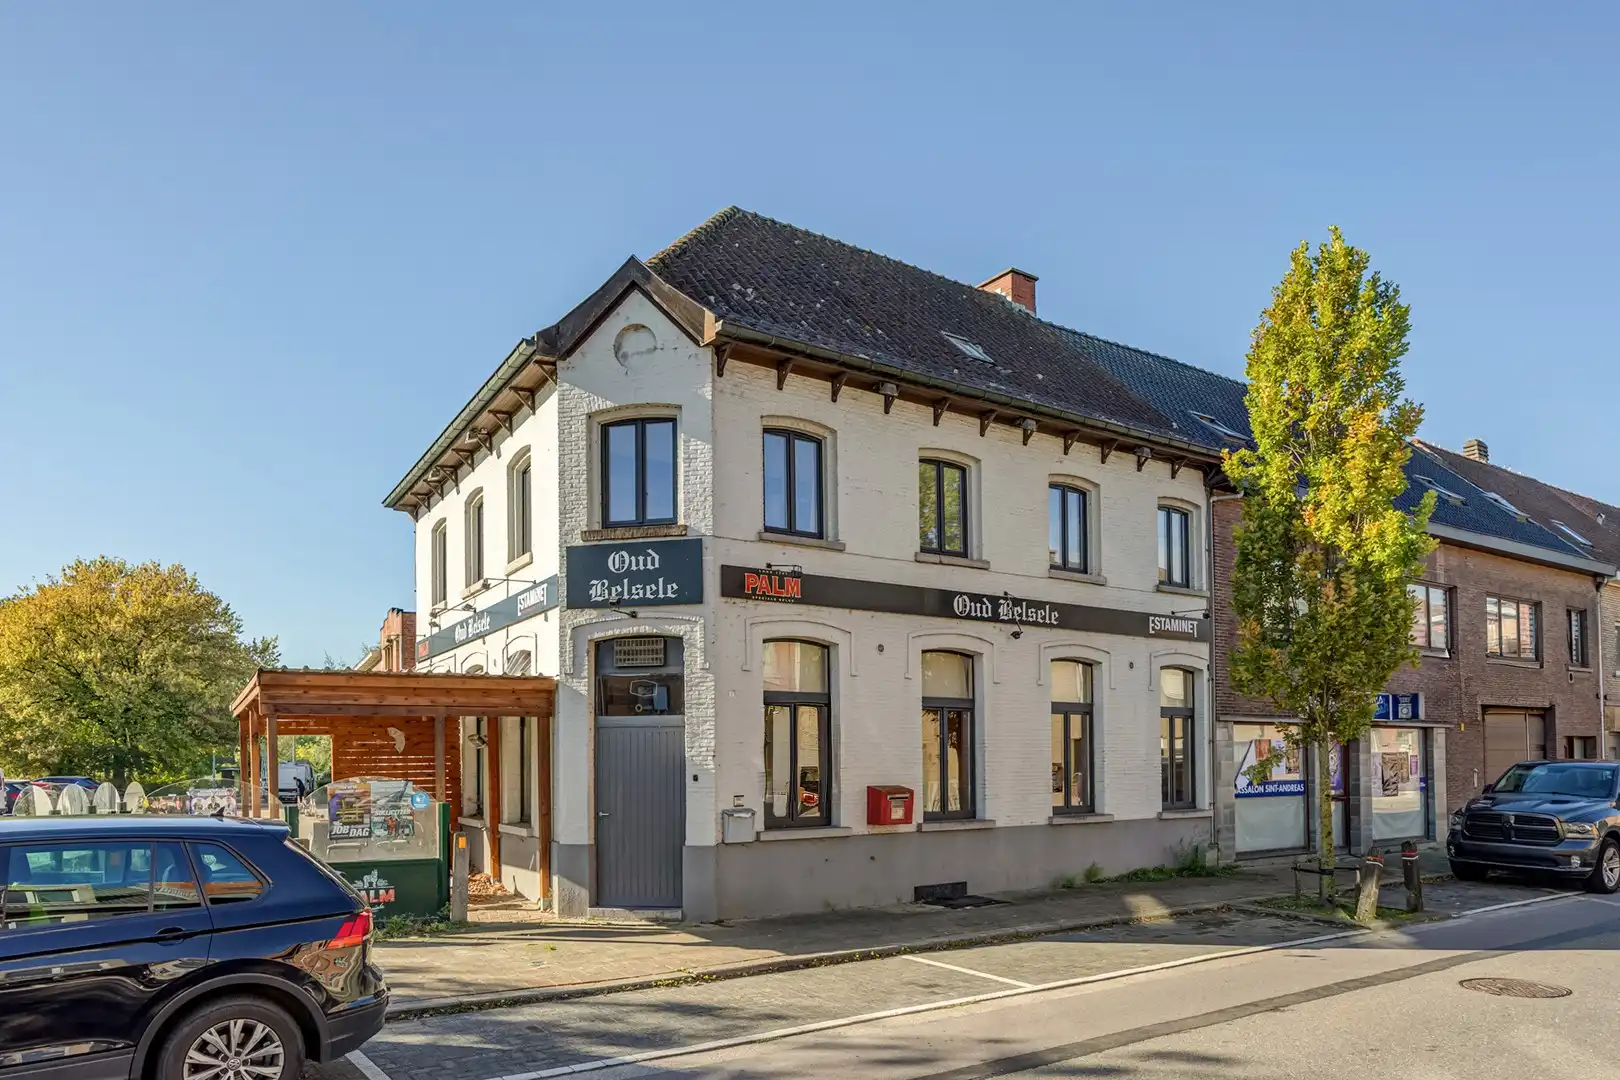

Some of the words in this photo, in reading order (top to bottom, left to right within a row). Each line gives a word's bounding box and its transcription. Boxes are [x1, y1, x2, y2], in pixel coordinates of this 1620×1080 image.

[607, 548, 660, 574] Oud
[588, 576, 679, 602] Belsele
[744, 573, 801, 598] PALM
[952, 593, 993, 618] Oud
[998, 599, 1060, 626] Belsele
[1148, 616, 1199, 638] ESTAMINET
[1235, 784, 1264, 794] ASSALON
[1264, 783, 1305, 793] SINT-ANDREAS
[331, 825, 350, 835] JOB
[349, 828, 370, 837] DAG
[359, 888, 396, 903] ALM
